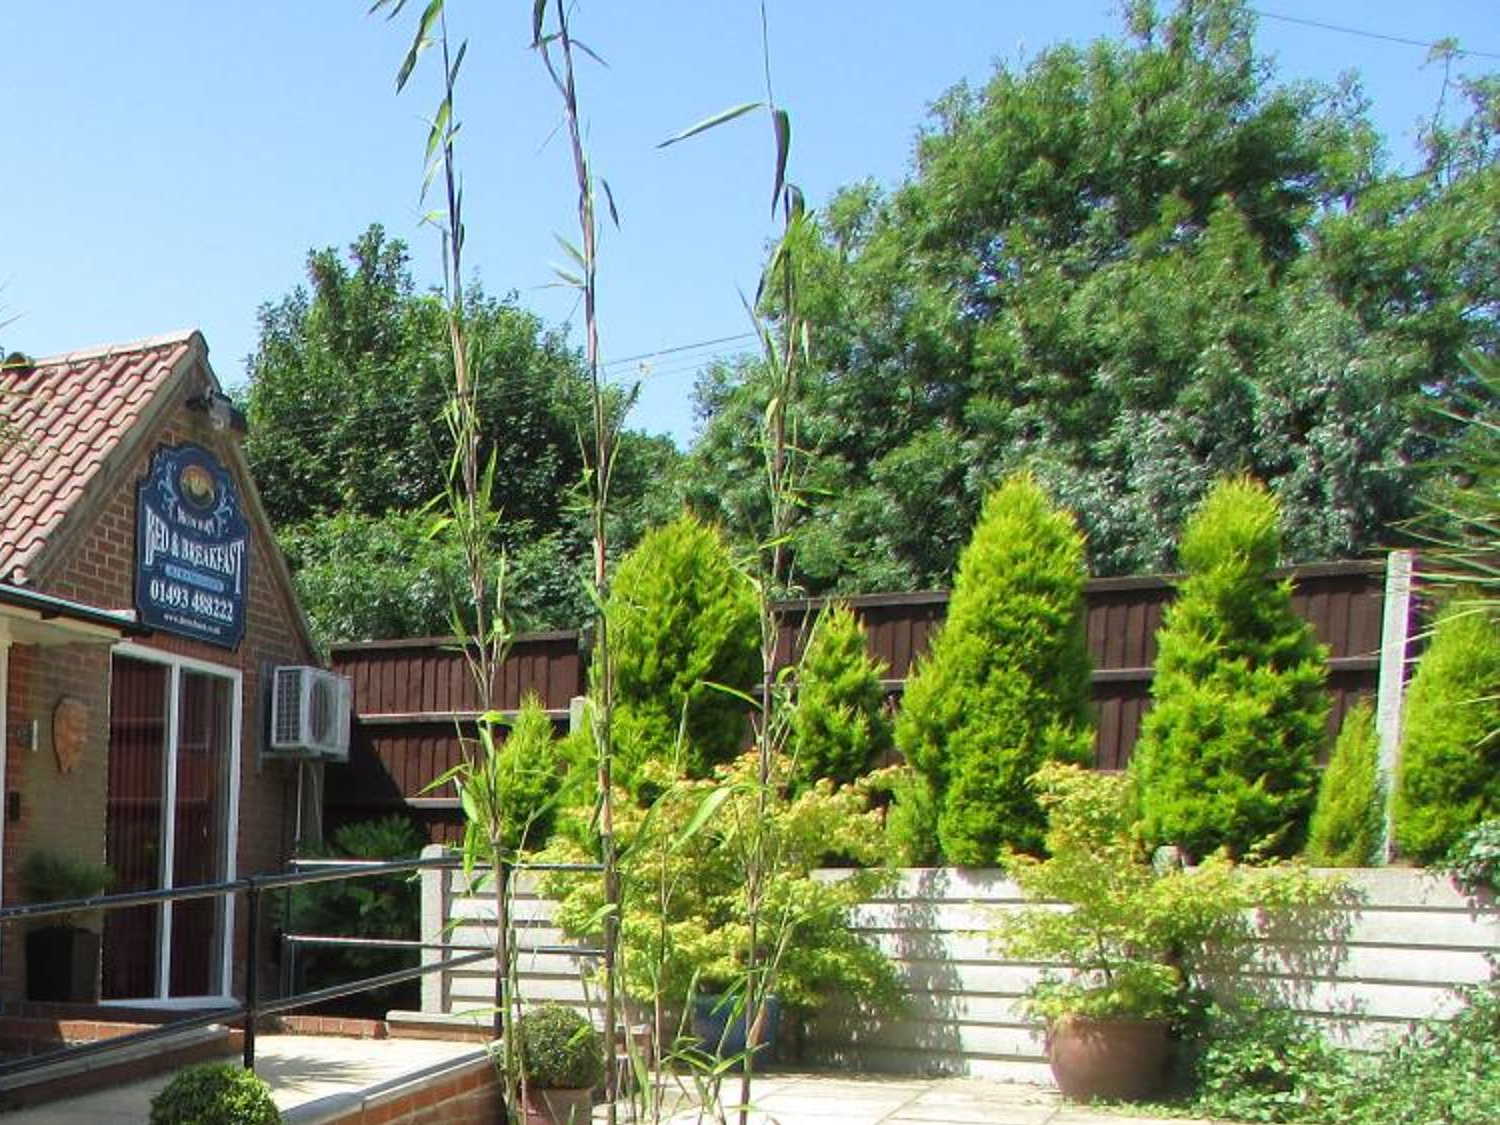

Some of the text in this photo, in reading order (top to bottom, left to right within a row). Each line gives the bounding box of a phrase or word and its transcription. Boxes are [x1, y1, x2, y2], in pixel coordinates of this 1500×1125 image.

[144, 504, 170, 566] BED
[171, 532, 181, 559] &
[181, 538, 245, 594] BREAKFAST
[151, 579, 189, 609] 01493
